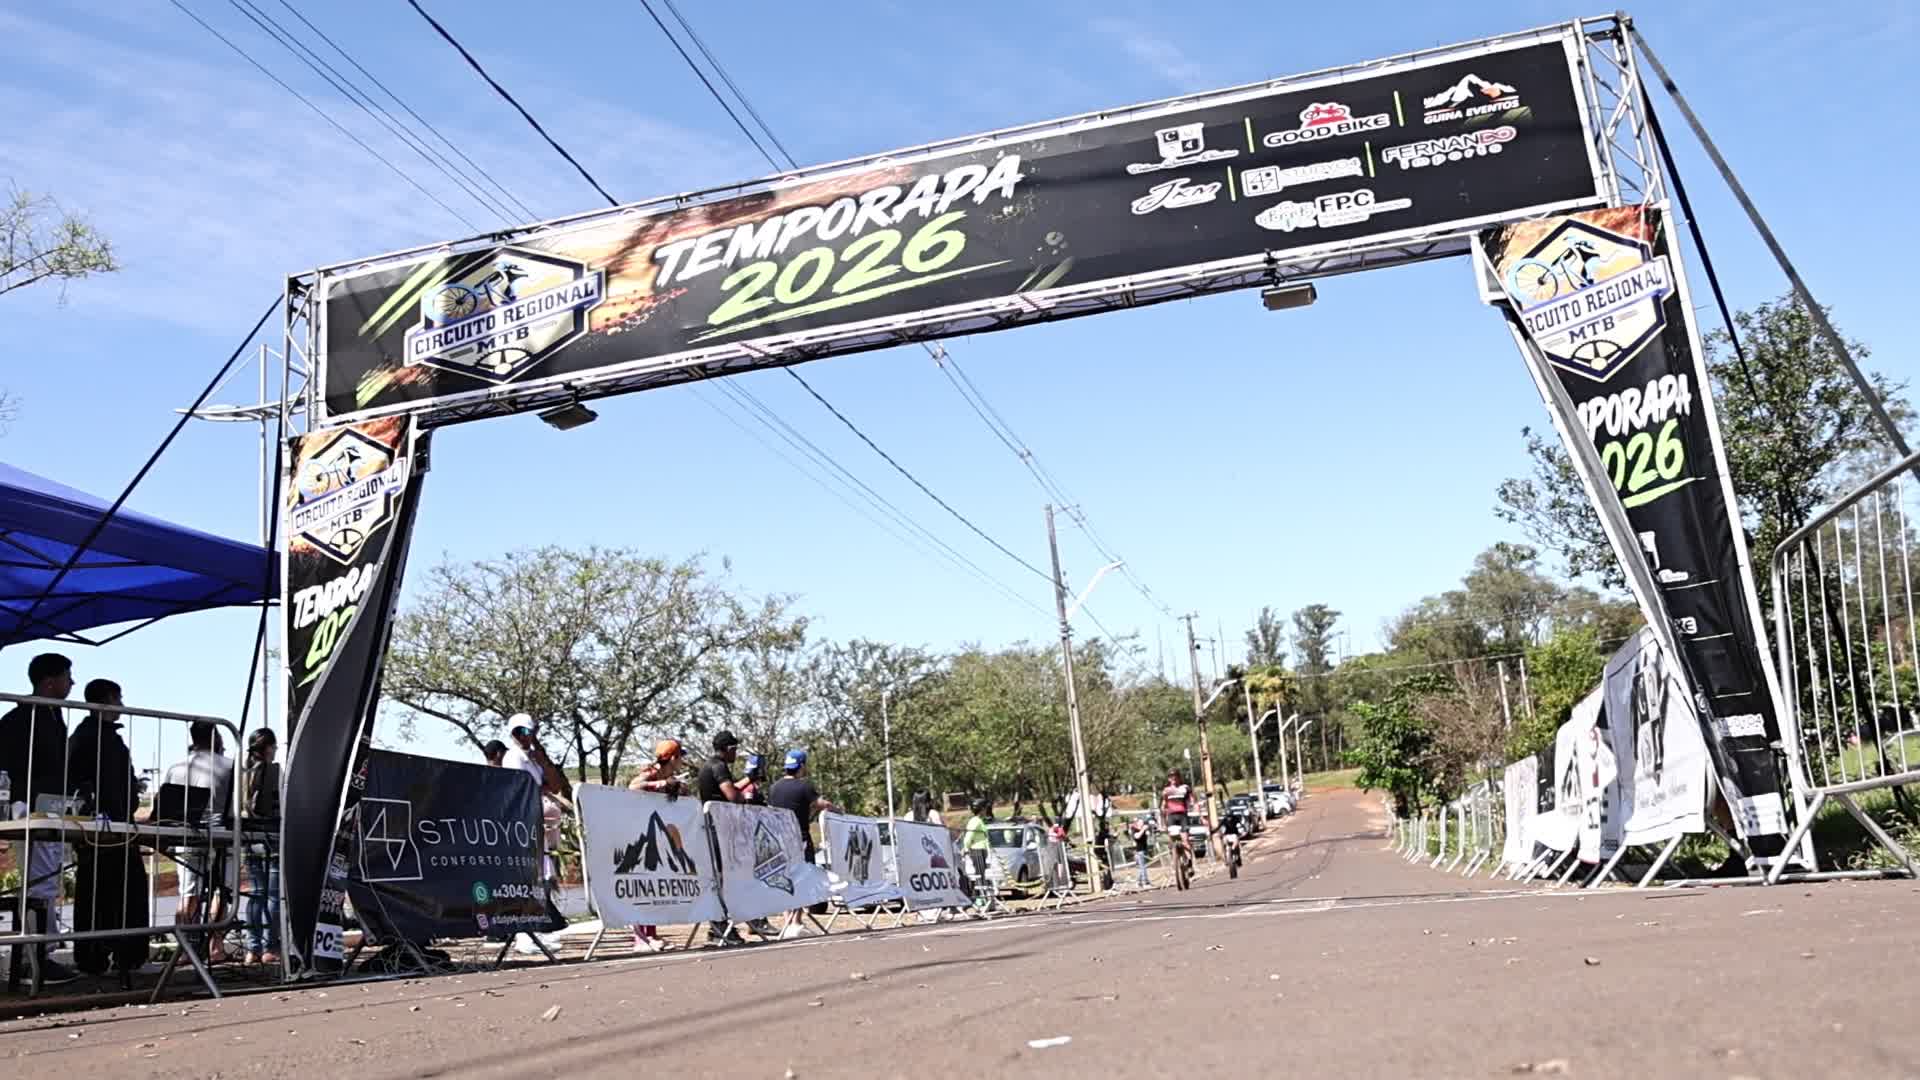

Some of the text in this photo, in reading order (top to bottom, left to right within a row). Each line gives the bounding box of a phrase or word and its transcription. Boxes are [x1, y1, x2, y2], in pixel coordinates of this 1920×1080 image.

[1423, 98, 1520, 125] GUINA EVENTOS
[1266, 114, 1389, 146] GOOD BIKE
[1384, 127, 1517, 162] FERNANDO
[654, 154, 1024, 288] TEMPORADA
[707, 211, 966, 325] 2026
[1526, 264, 1662, 338] RCUITO REGIONAL
[415, 281, 595, 355] CIRCUITO REGIONAL
[1568, 315, 1616, 345] MTB
[476, 327, 530, 354] MTB
[1602, 417, 1684, 493] 026
[295, 495, 345, 530] CIRCUITO
[330, 508, 363, 532] MTB
[430, 855, 501, 867] CONFORTO
[615, 879, 701, 899] GUINA EVENTOS
[910, 872, 948, 893] GOOD
